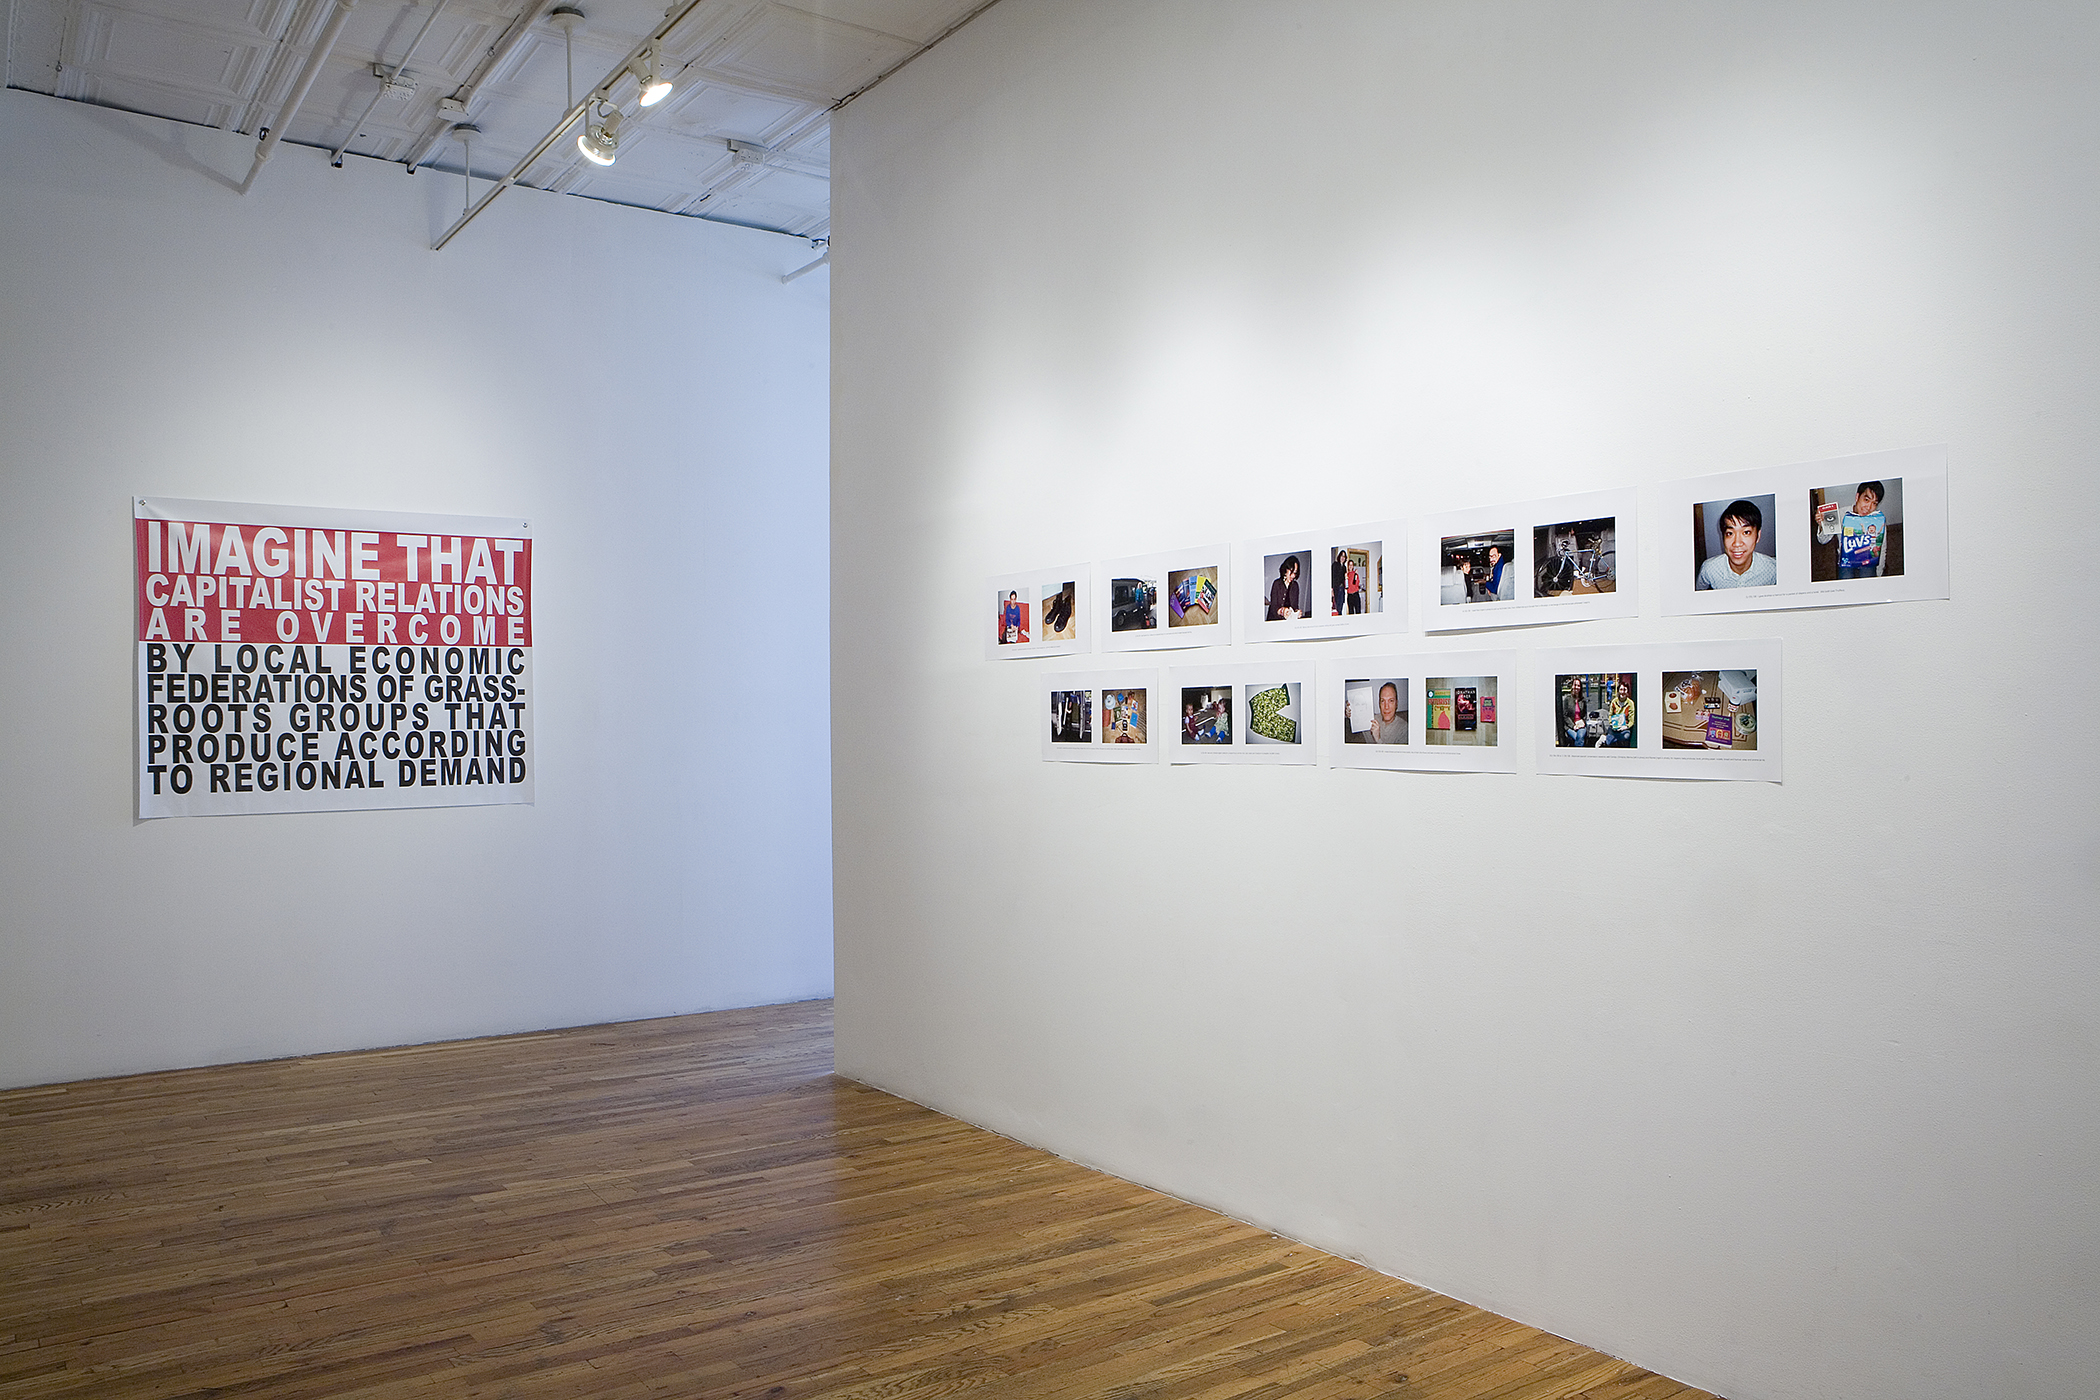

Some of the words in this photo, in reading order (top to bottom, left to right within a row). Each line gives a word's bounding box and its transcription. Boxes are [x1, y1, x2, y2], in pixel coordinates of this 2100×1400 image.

[147, 521, 380, 581] IMAGINE
[397, 534, 523, 585] THAT
[145, 573, 345, 612] CAPITALIST
[356, 581, 524, 615] RELATIONS
[145, 607, 242, 642] ARE
[276, 611, 524, 646] OVERCOME
[147, 644, 194, 673] BY
[214, 644, 331, 674] LOCAL
[350, 647, 525, 675] ECONOMIC
[147, 674, 367, 703] FEDERATIONS
[377, 675, 414, 703] OF
[424, 675, 526, 702] GRASS-
[148, 703, 271, 734] ROOTS
[289, 703, 429, 732] GROUPS
[445, 702, 526, 730] THAT
[148, 732, 320, 765] PRODUCE
[335, 731, 526, 761] ACCORDING
[147, 764, 193, 795] TO
[210, 761, 384, 793] REGIONAL
[399, 758, 526, 787] DEMAND
